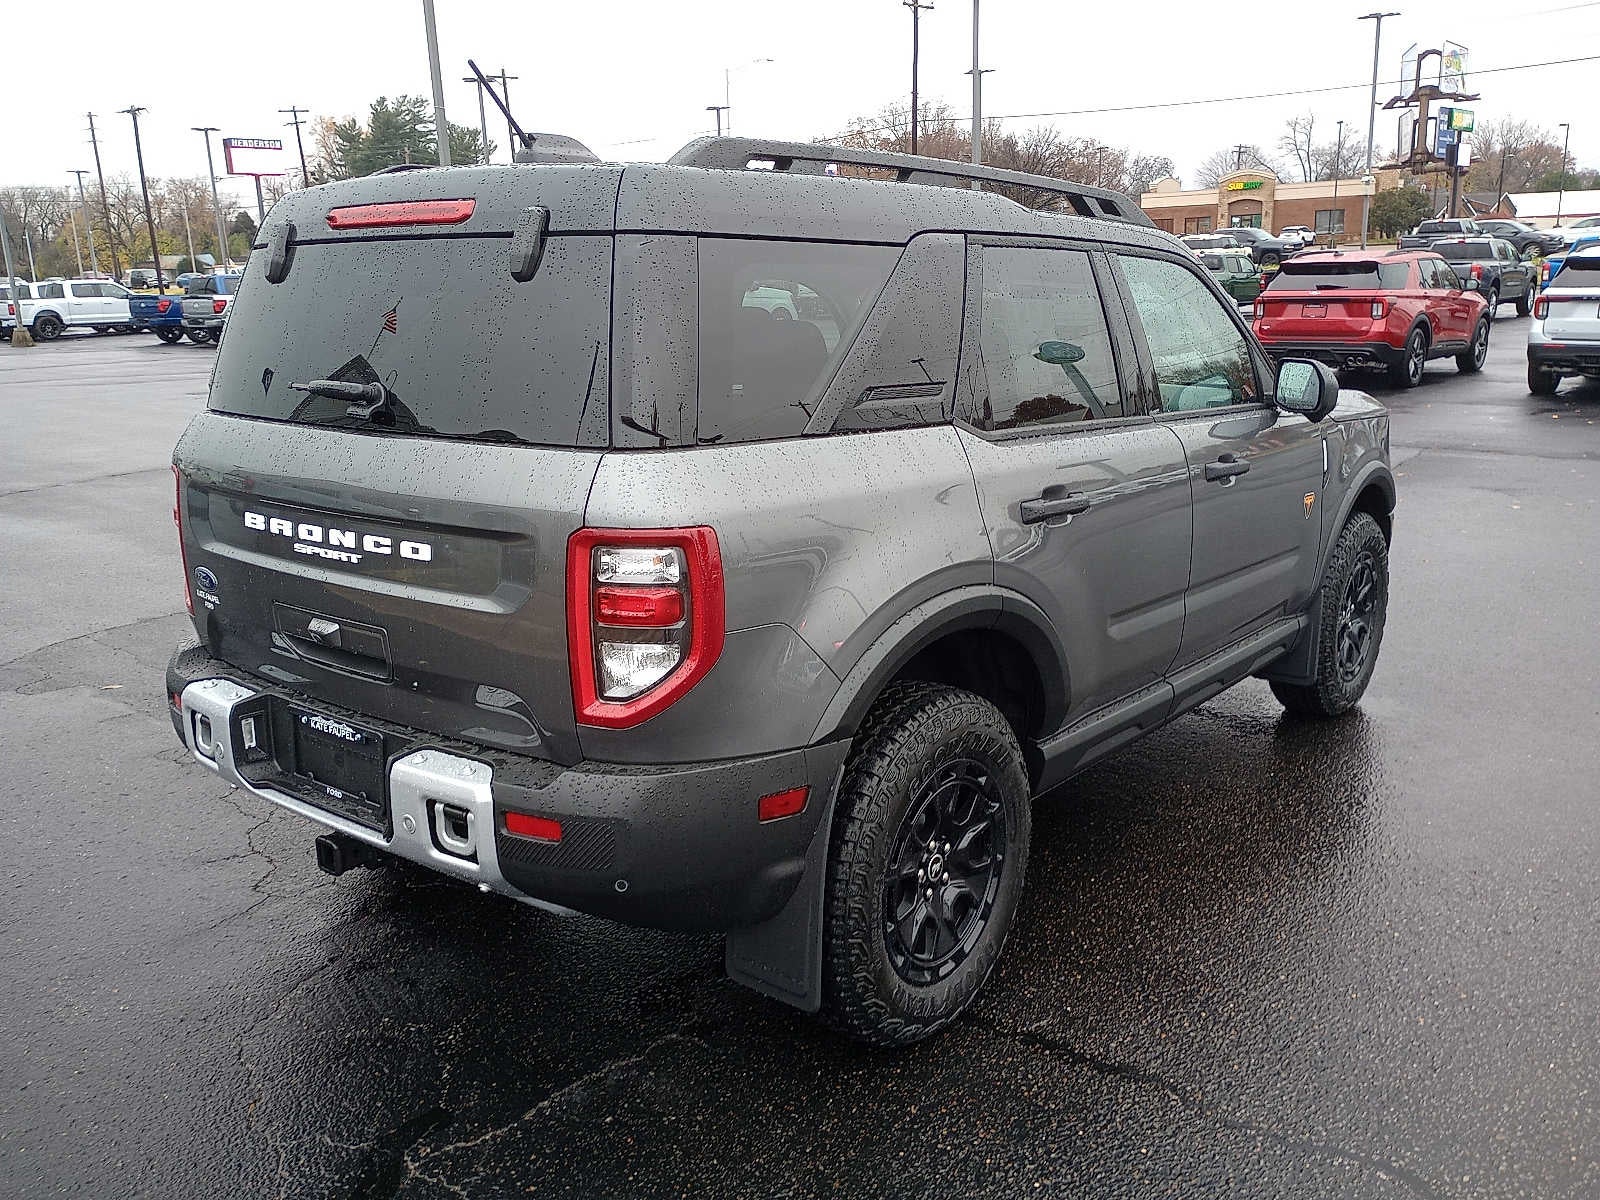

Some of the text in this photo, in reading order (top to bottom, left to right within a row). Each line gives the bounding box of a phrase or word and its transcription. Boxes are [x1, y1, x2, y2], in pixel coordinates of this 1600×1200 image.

[1227, 181, 1263, 191] SUBWAY
[244, 511, 432, 562] BRONCO
[293, 543, 363, 564] SPORT
[310, 719, 355, 741] KATE FAUPEL
[326, 787, 343, 799] FORD
